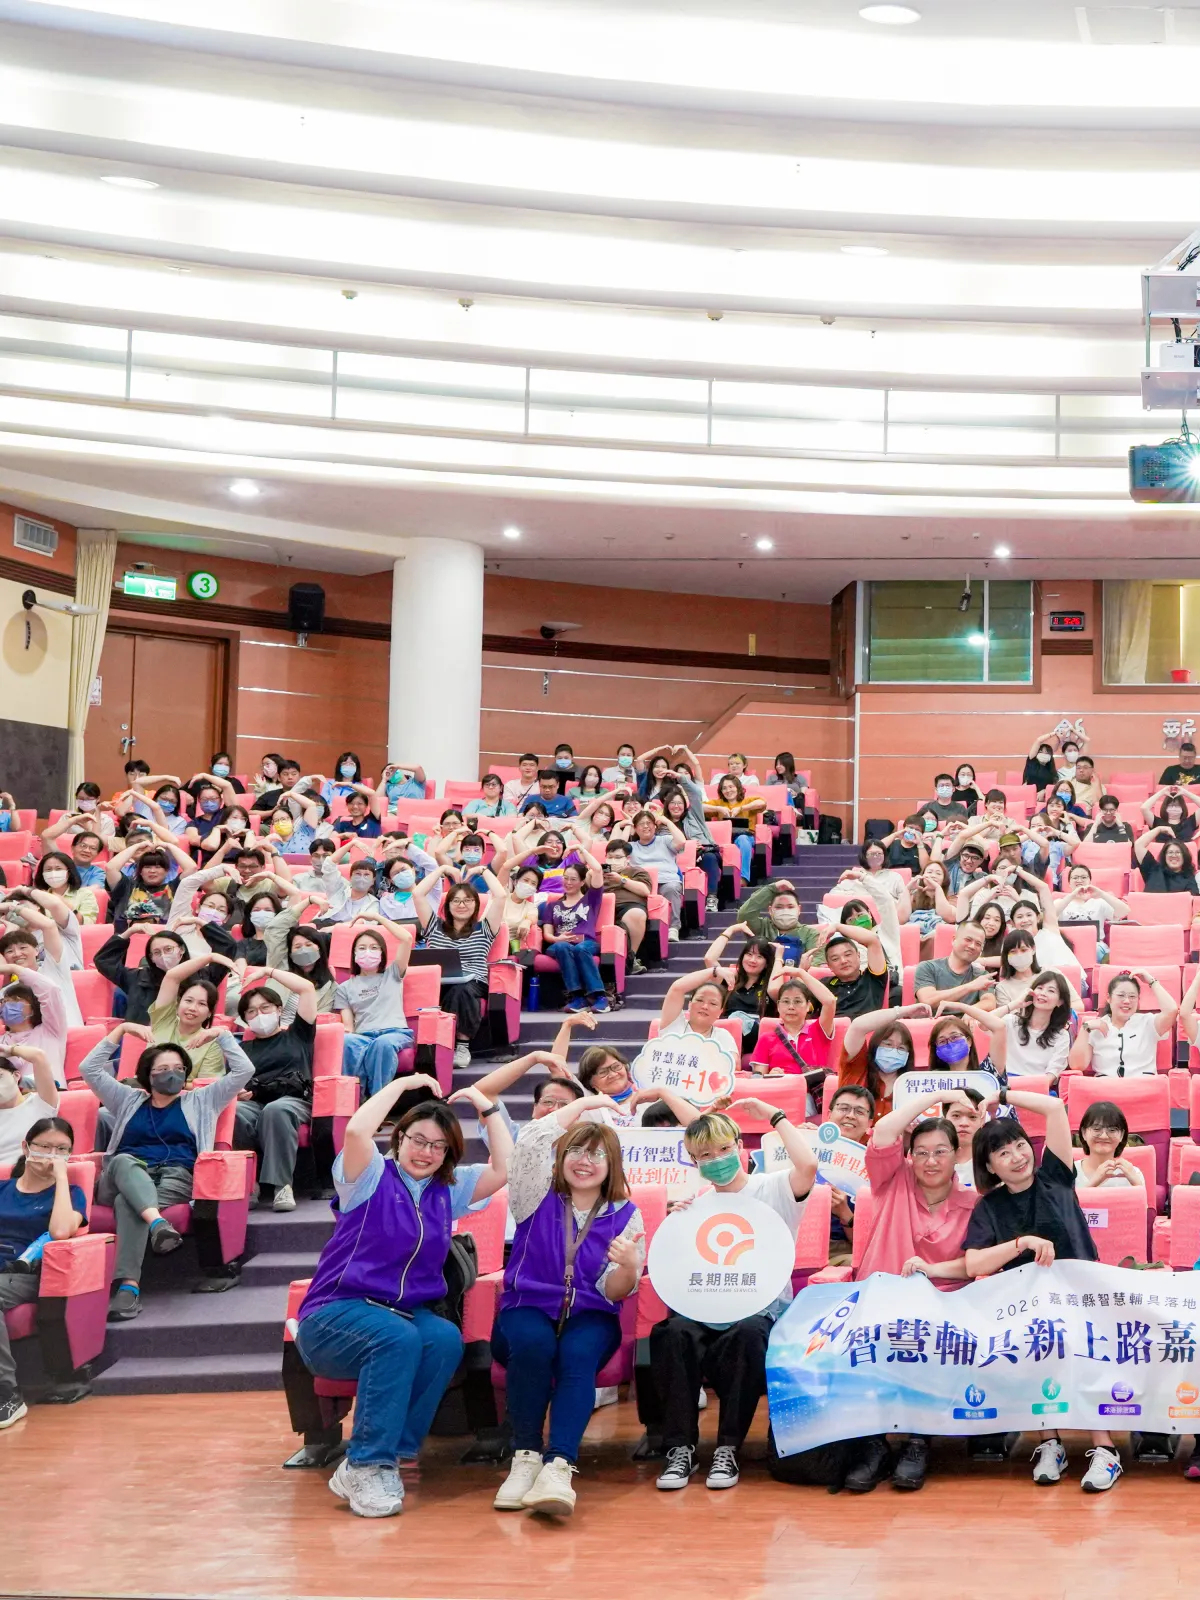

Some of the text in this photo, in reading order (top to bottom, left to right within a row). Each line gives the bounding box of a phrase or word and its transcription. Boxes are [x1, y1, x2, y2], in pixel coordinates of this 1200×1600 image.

[199, 578, 210, 594] 3
[652, 1049, 699, 1069] 智慧嘉義
[906, 1078, 969, 1093] 智慧輔具
[620, 1146, 676, 1163] 有智慧
[622, 1167, 688, 1184] 最到位!
[688, 1272, 757, 1286] 長期照顧
[995, 1296, 1040, 1321] 2026
